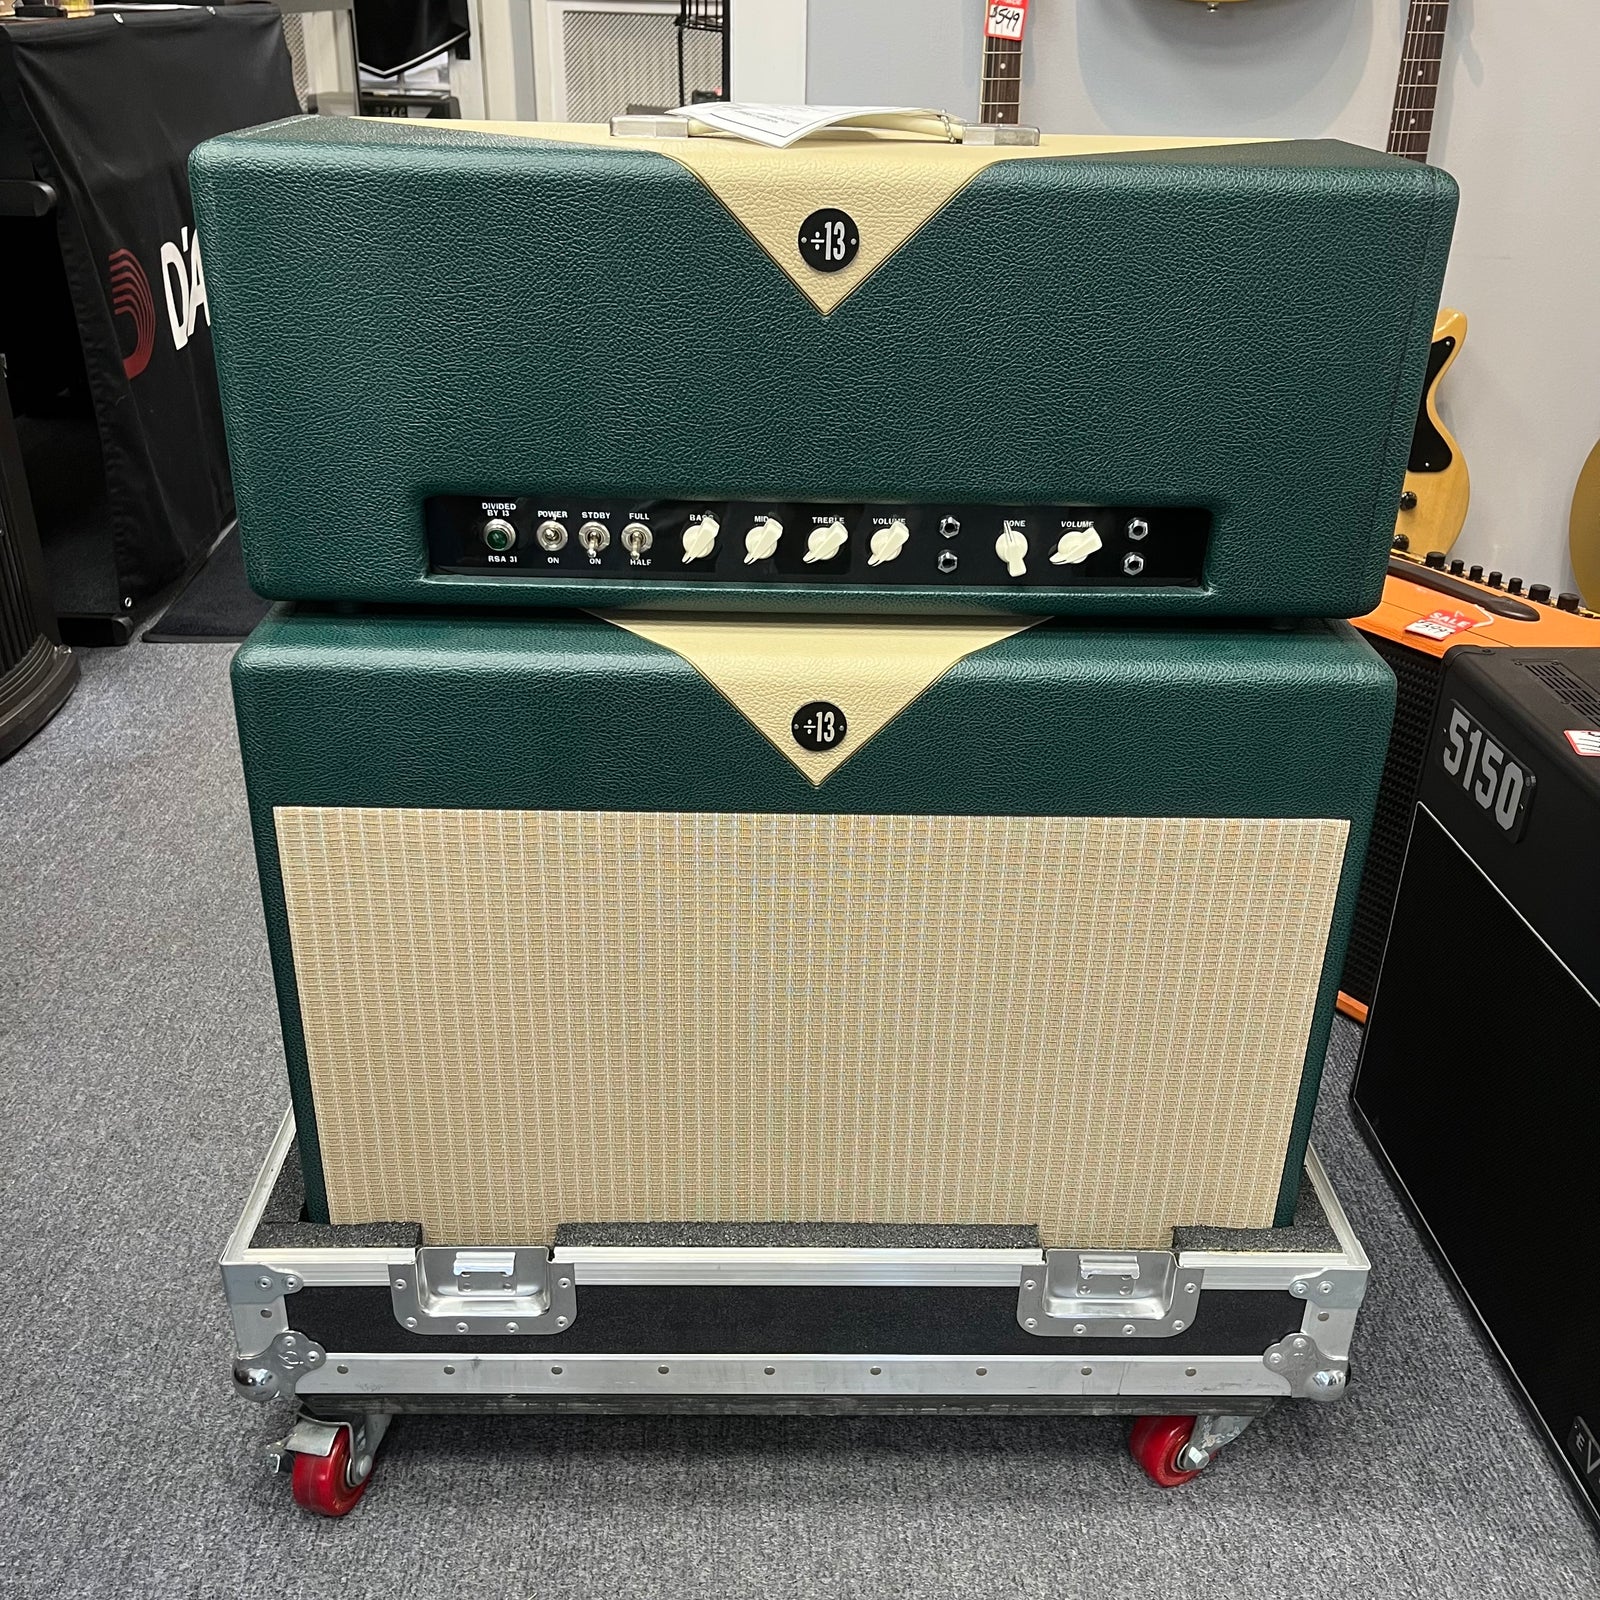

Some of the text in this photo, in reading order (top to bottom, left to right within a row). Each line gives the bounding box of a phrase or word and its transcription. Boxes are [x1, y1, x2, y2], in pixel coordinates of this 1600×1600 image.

[481, 502, 517, 510] DIVIDED
[537, 510, 568, 518] POWER
[581, 511, 611, 519] STDBY
[629, 512, 650, 520] FULL
[488, 555, 507, 563] RSA
[547, 556, 560, 564] ON
[630, 558, 652, 566] HALF
[1429, 611, 1472, 629] SALE
[1443, 707, 1525, 831] 5150
